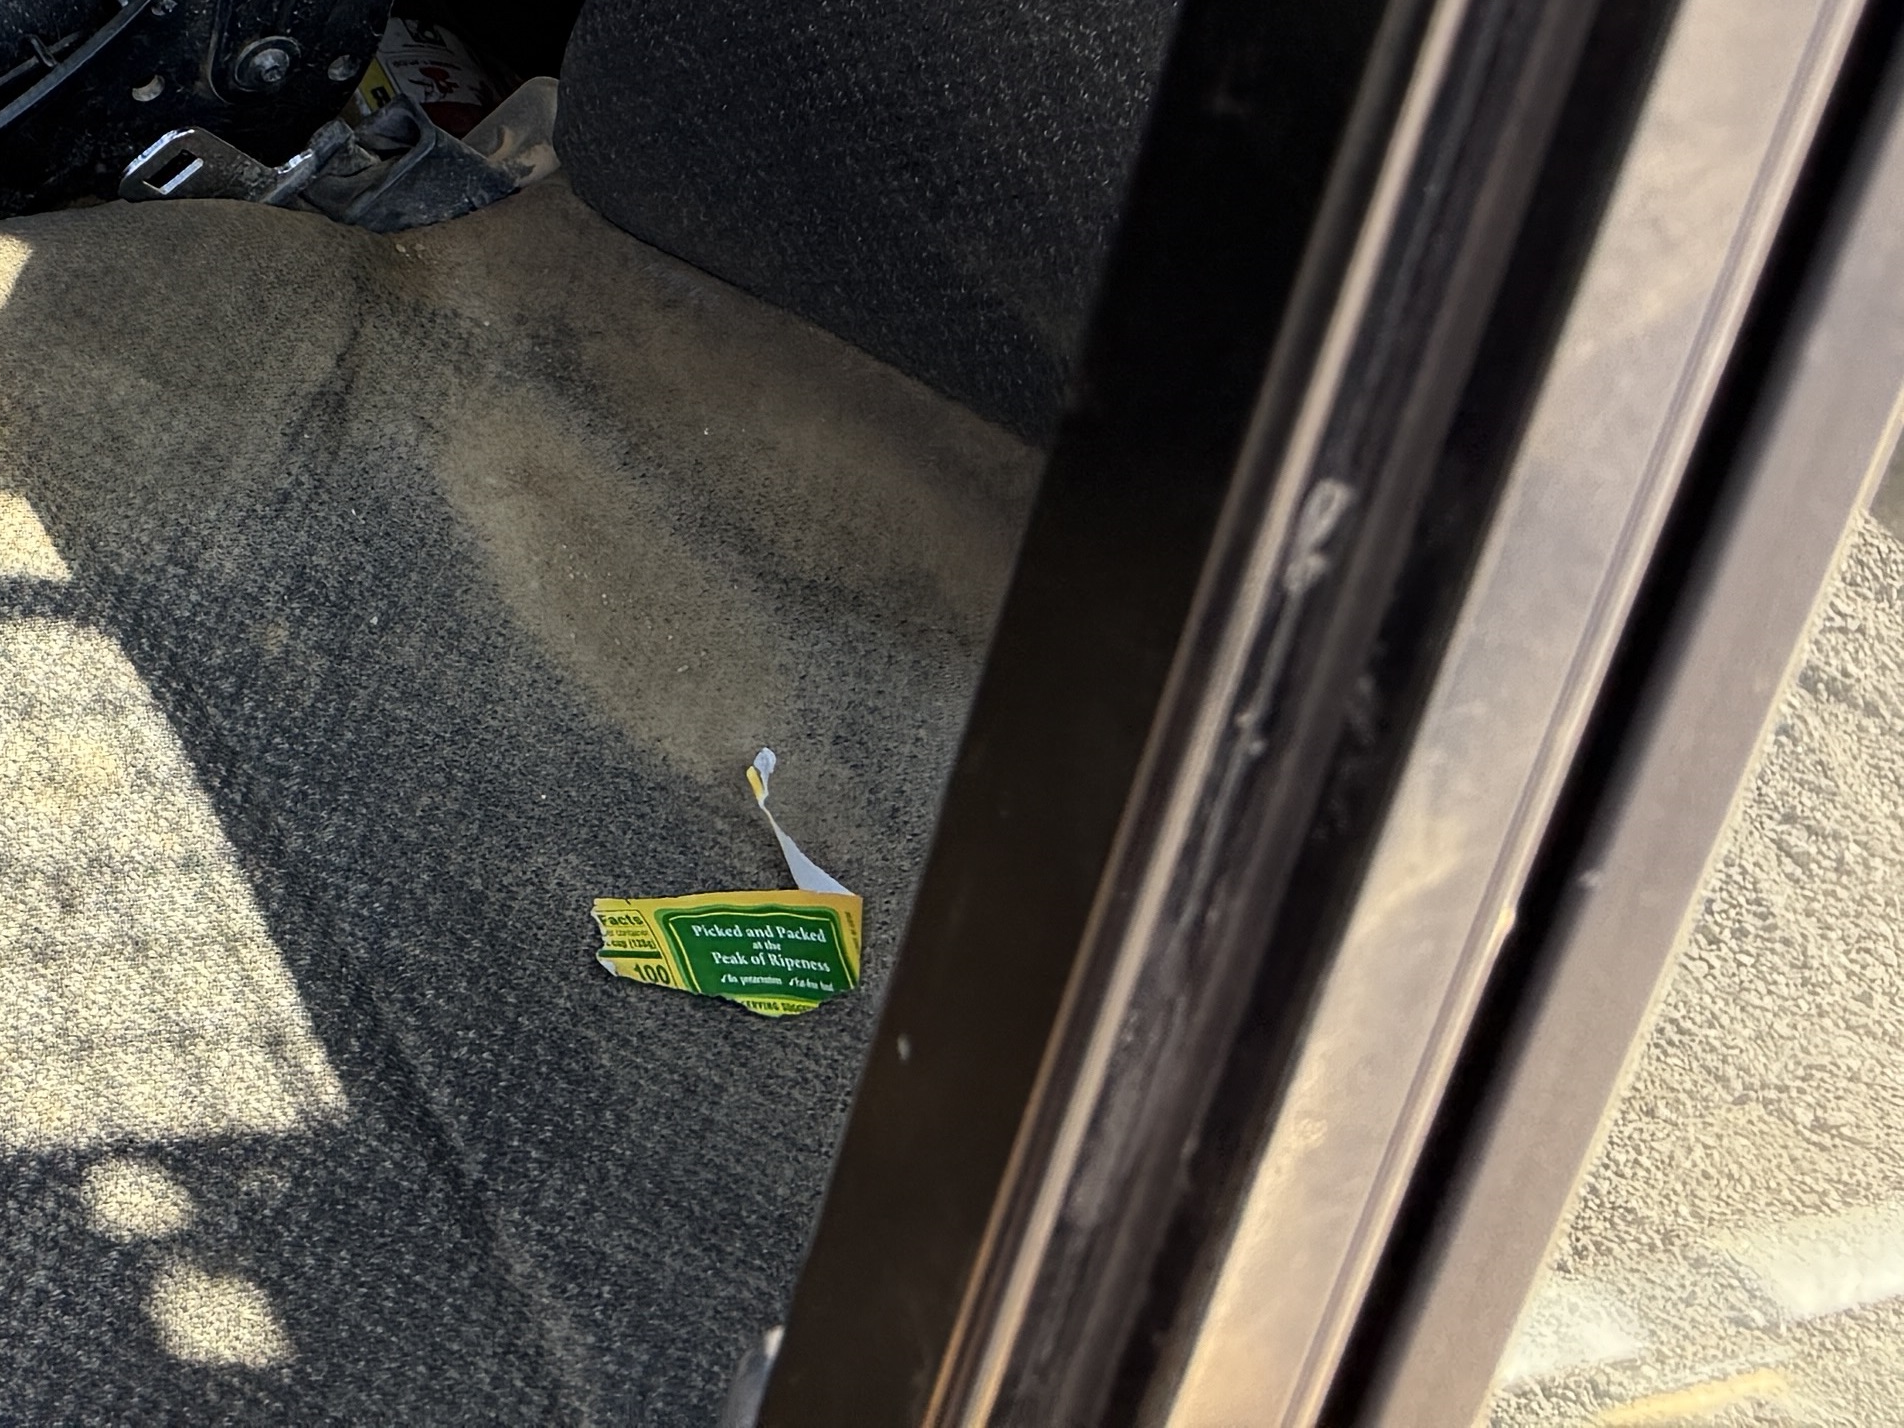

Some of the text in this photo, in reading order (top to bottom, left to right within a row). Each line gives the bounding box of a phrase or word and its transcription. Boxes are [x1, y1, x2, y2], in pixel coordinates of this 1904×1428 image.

[597, 913, 644, 925] Facts
[691, 924, 827, 943] Picked and Packed
[752, 939, 781, 951] at the
[711, 951, 831, 972] Peak of Ripeness
[633, 963, 671, 984] 100
